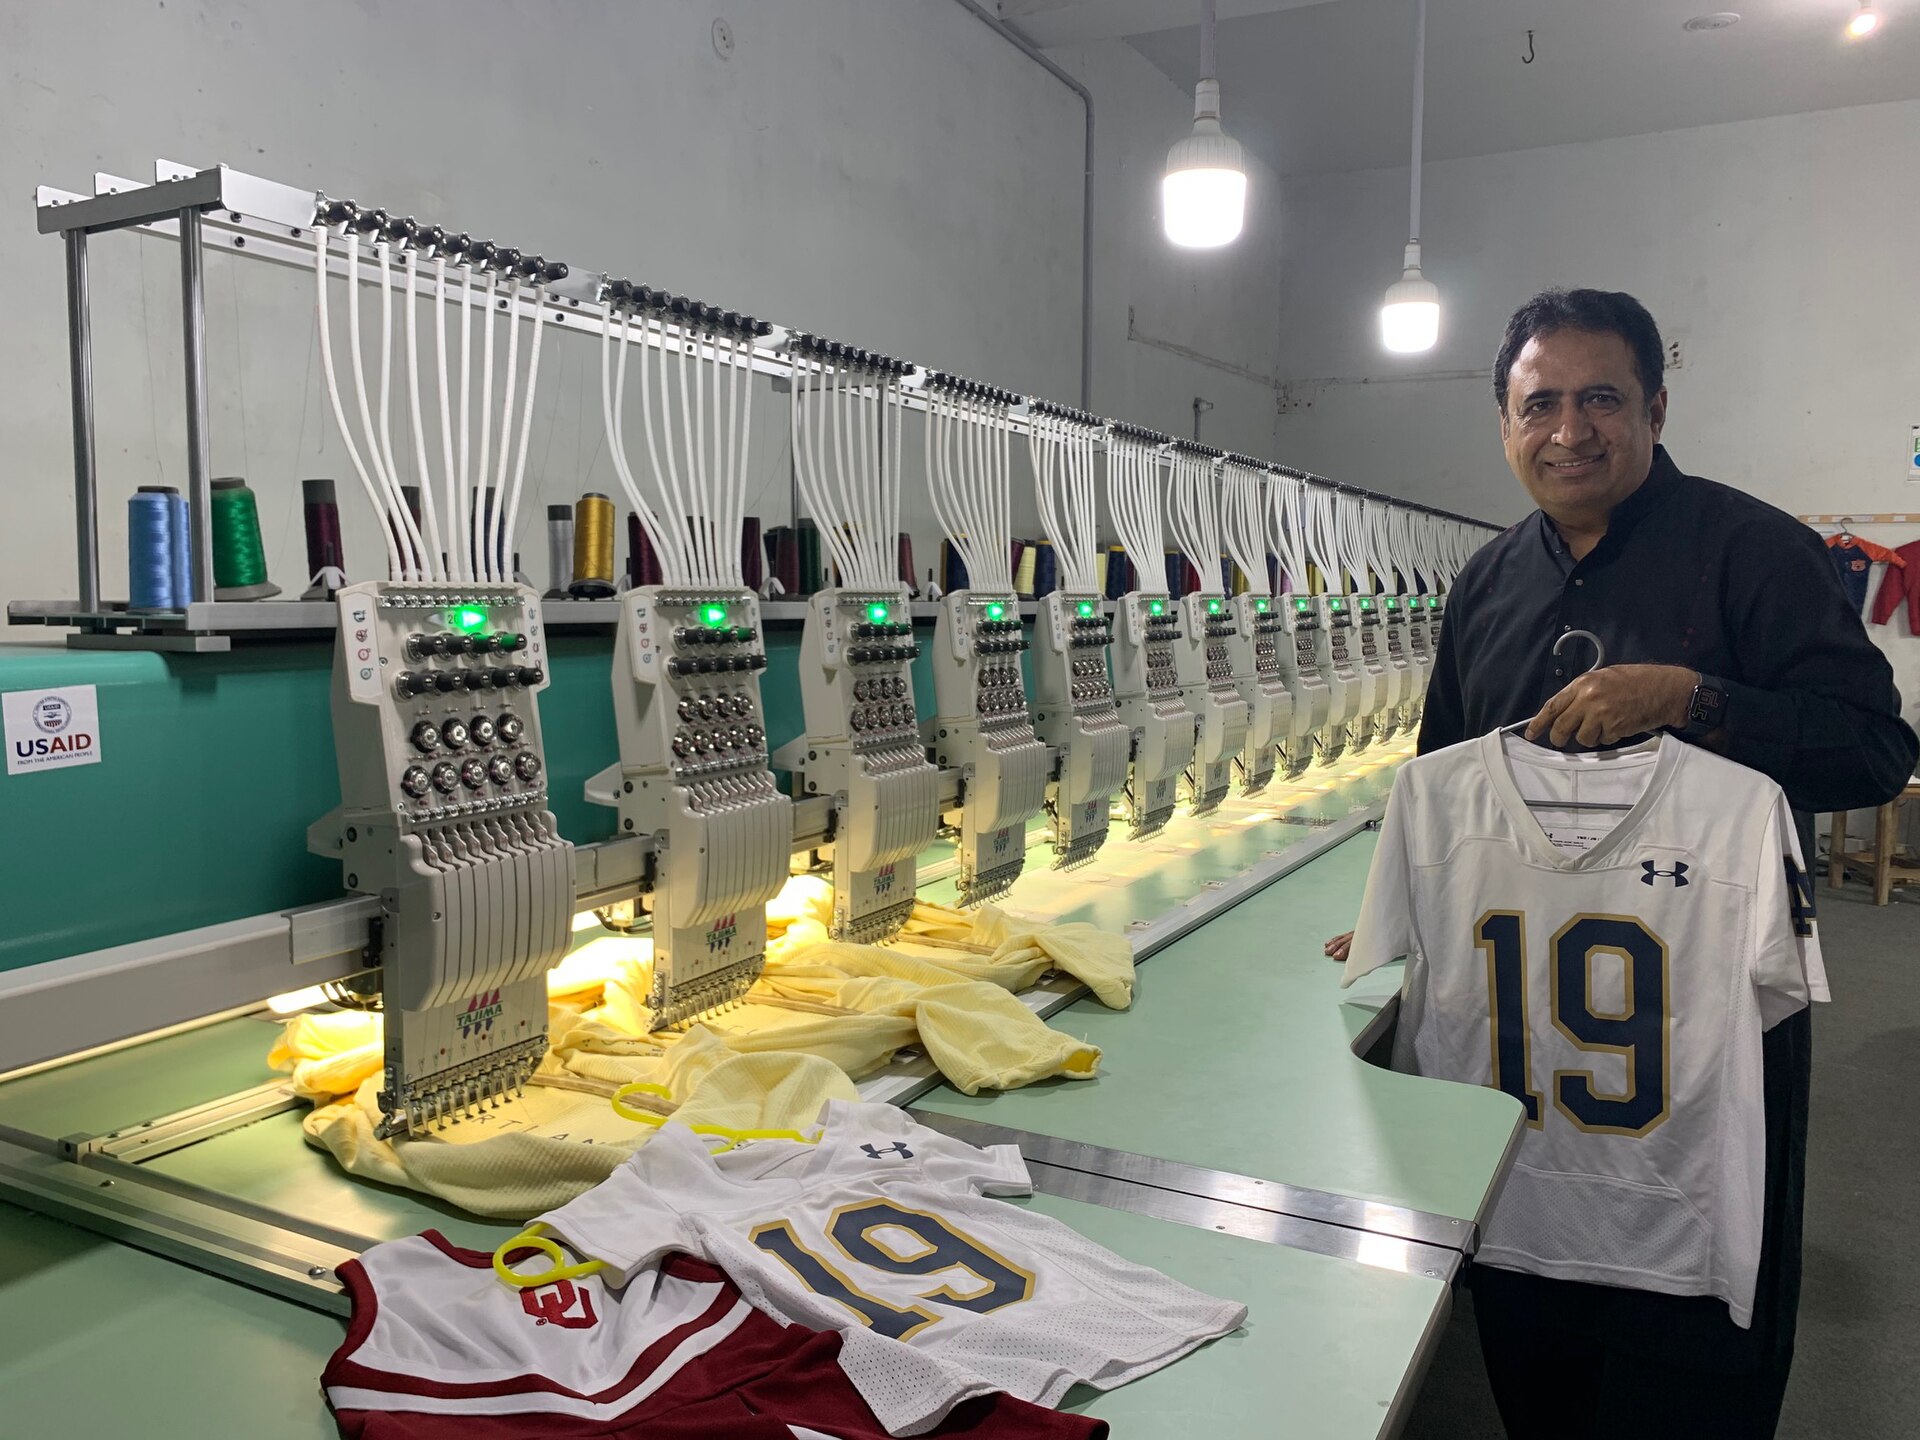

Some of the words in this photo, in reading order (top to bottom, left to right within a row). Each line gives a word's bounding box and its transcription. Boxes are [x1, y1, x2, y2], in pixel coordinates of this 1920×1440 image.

[16, 733, 92, 758] USAID
[706, 926, 737, 943] TAJIMA
[456, 1003, 502, 1027] TAJIMA
[1473, 909, 1671, 1139] 19
[749, 1197, 1036, 1342] 19
